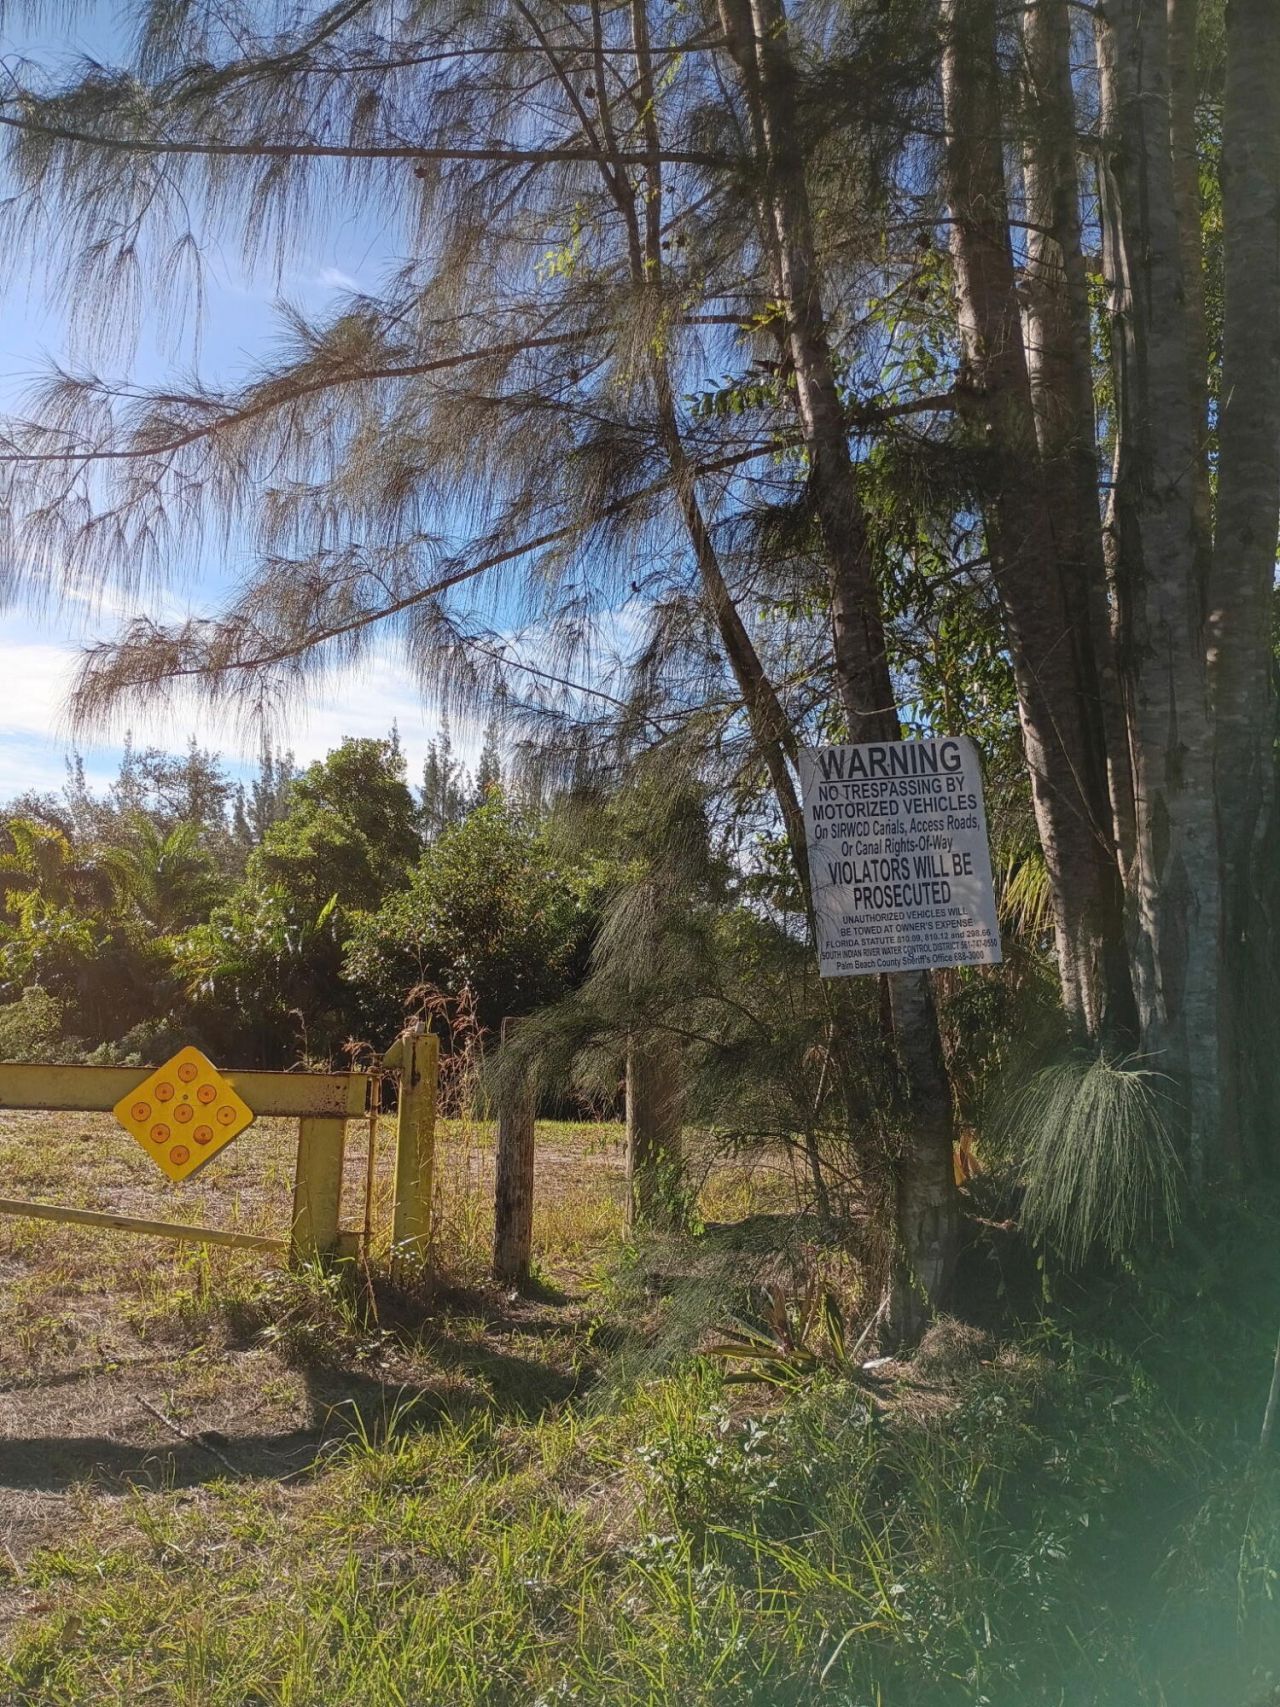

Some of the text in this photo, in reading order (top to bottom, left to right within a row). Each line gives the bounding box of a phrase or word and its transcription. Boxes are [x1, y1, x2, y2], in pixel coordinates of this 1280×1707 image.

[819, 742, 961, 780] WARNING
[819, 777, 965, 801] NO TRESPASSING BY
[813, 795, 977, 820] MOTORIZED VEHICLES
[815, 814, 980, 839] On SIRWCD Canals, Access Roads,
[842, 836, 953, 857] Or Canal Rights-Of-Way
[829, 853, 973, 884] VIOLATORS WILL BE
[854, 881, 951, 910] PROSECUTED
[842, 907, 968, 925] UNAUTHORIZED VEHICLES WILL
[840, 919, 973, 936] BE TOWED AT OWNER'S EXPENSE
[821, 950, 841, 960] SOUTH
[843, 948, 862, 958] INDIAN
[863, 946, 881, 957] RIVER
[882, 945, 903, 956] WATER
[904, 942, 930, 954] CONTROL
[932, 940, 959, 952] DISTRICT
[826, 939, 858, 949] FLORIDA
[861, 936, 895, 946] STATUTE
[951, 929, 964, 939] and
[836, 960, 853, 970] Palm
[855, 958, 875, 969] Beach
[877, 956, 900, 968] County
[932, 953, 953, 963] Office
